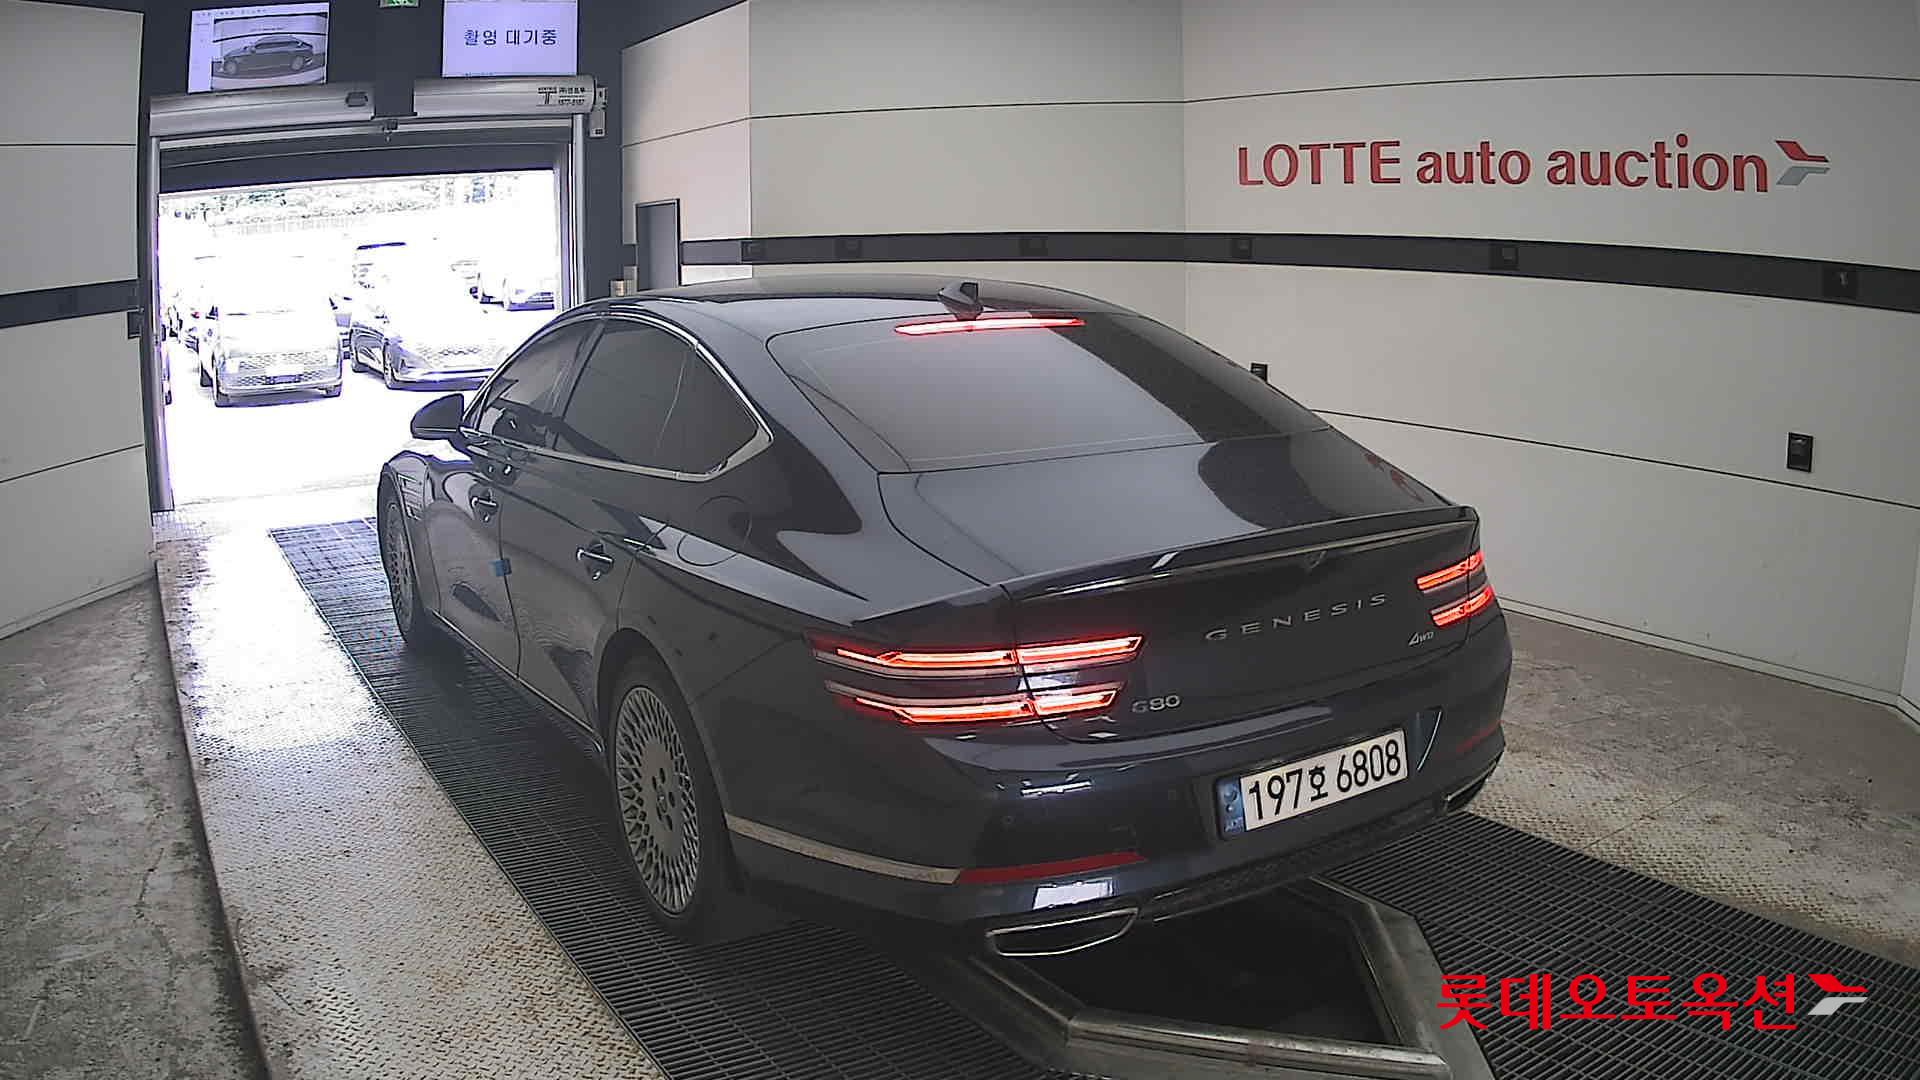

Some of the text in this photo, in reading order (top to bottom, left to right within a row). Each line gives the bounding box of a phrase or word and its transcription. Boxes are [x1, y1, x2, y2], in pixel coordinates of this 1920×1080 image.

[506, 30, 557, 46] 대기중
[1238, 133, 1769, 193] LOTTE auto auction
[1205, 593, 1386, 641] GENESIS
[1131, 695, 1181, 713] G80
[1248, 739, 1400, 820] 197호 6808
